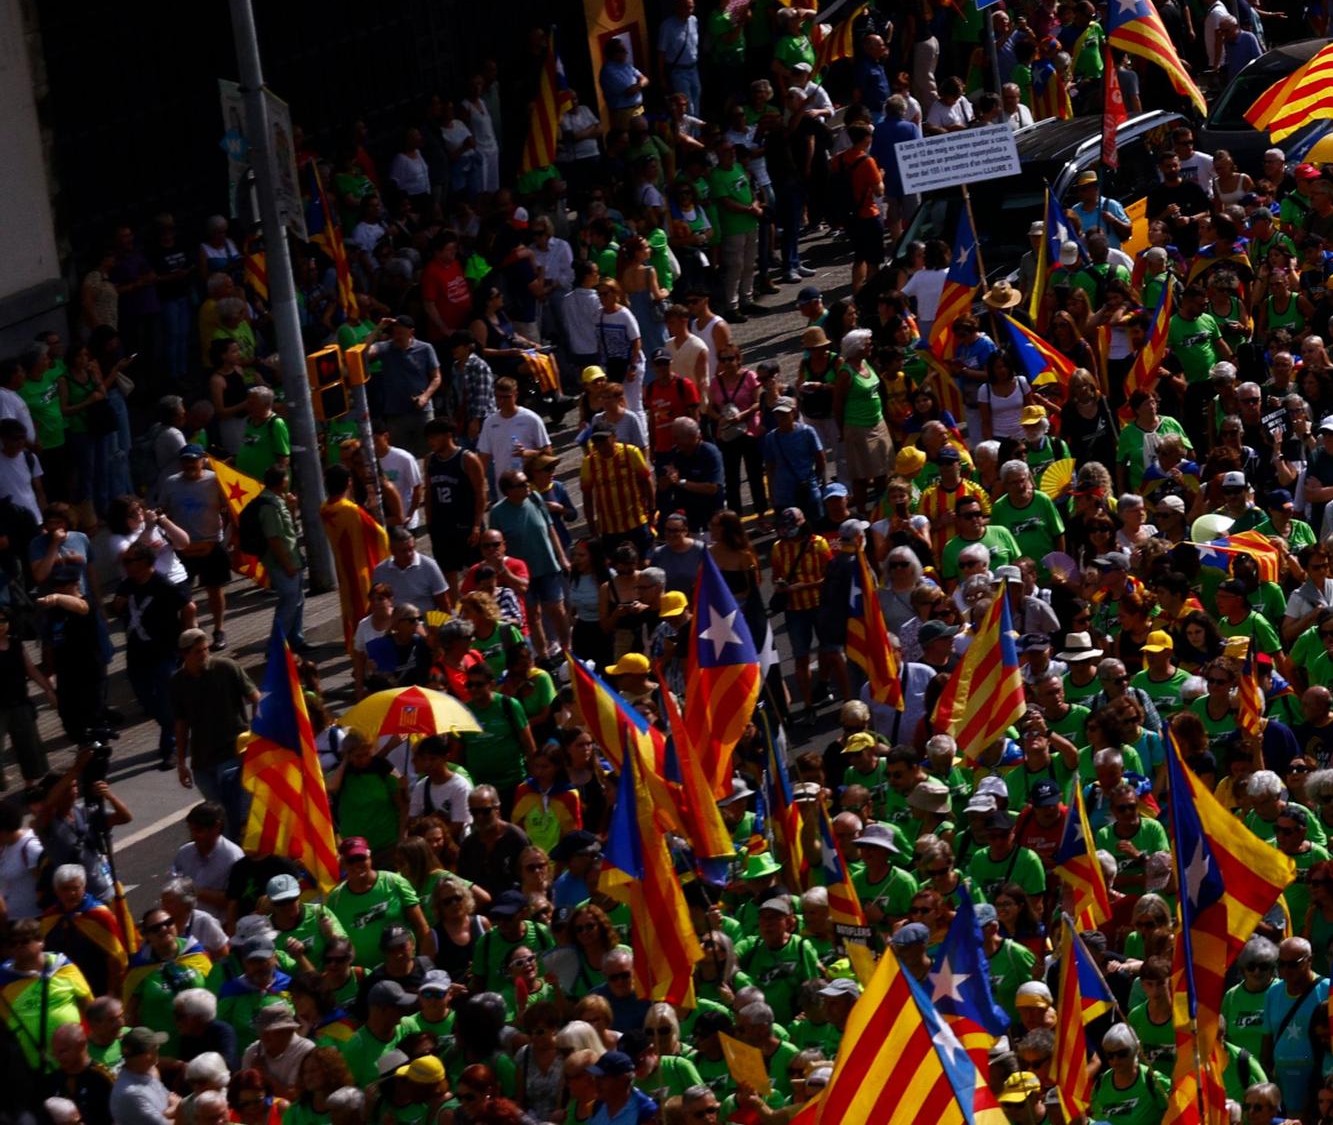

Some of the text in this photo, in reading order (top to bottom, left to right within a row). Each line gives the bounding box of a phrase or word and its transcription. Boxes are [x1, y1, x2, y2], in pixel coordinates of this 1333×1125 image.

[934, 147, 948, 155] maig
[944, 152, 969, 163] president
[951, 161, 969, 170] contra
[983, 164, 1007, 175] LLIURE
[436, 486, 452, 503] 12
